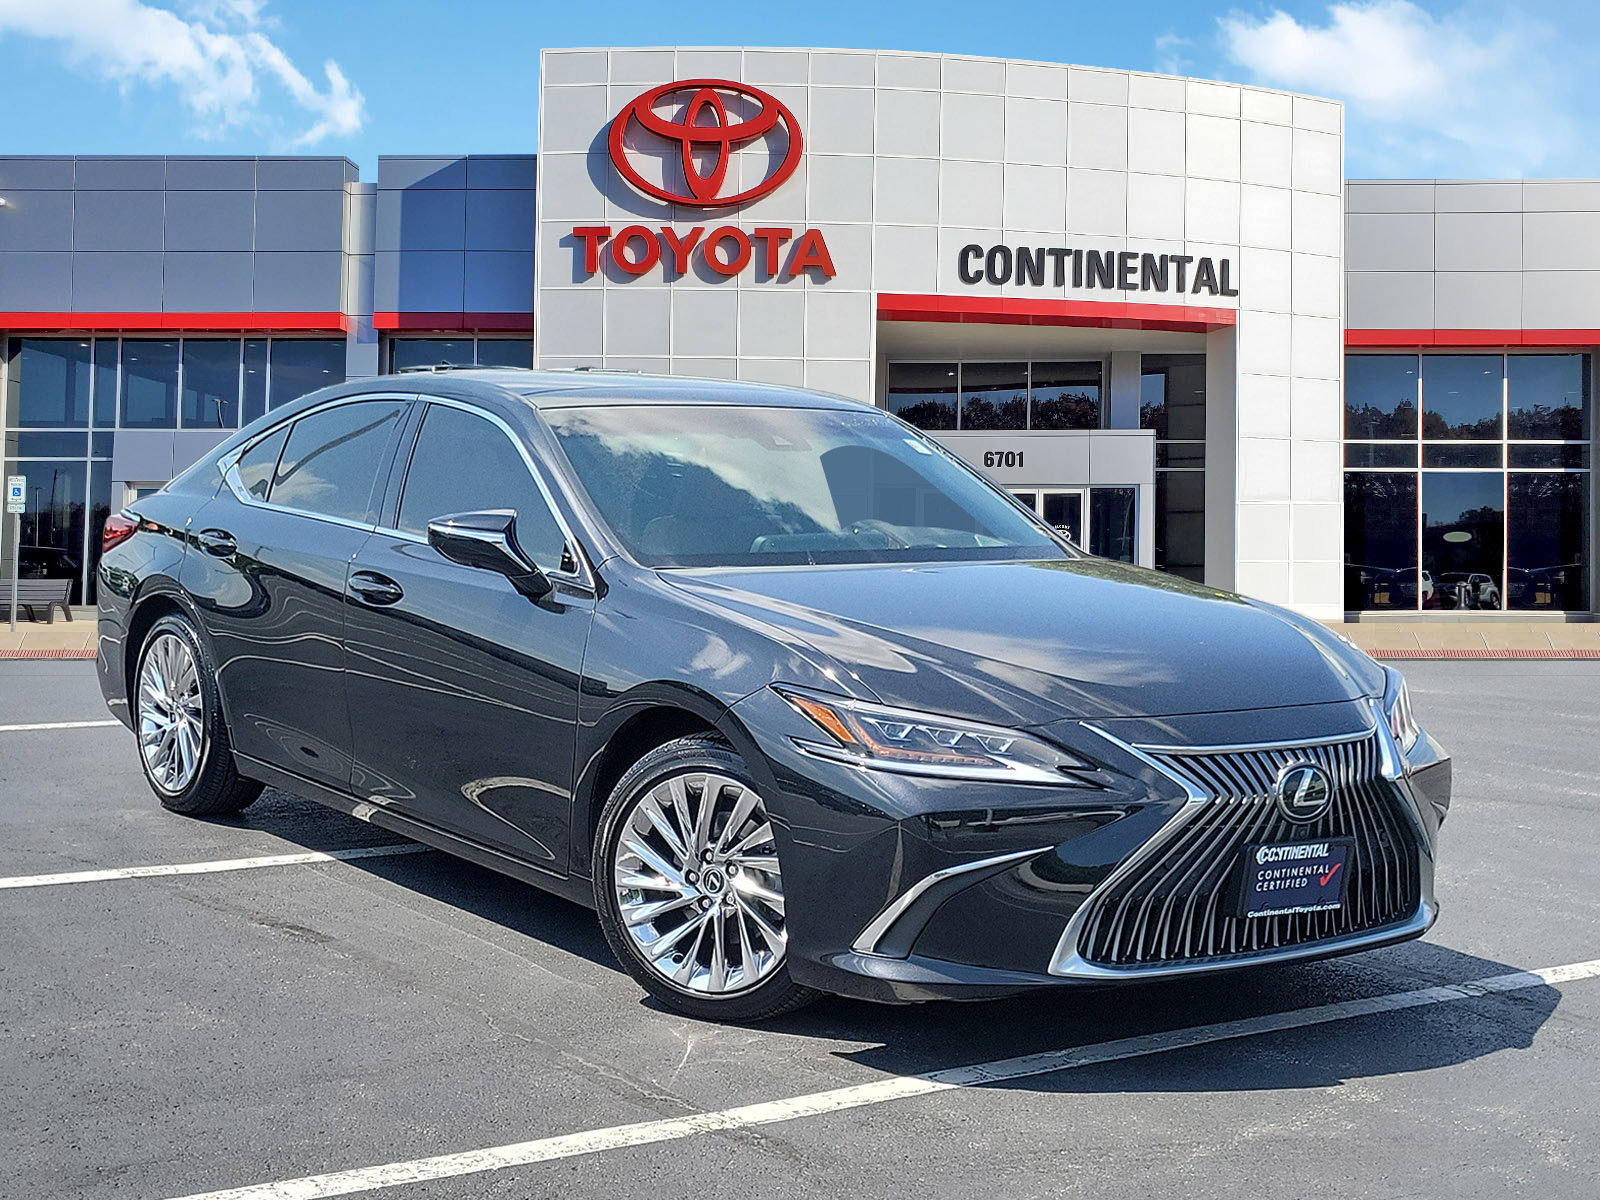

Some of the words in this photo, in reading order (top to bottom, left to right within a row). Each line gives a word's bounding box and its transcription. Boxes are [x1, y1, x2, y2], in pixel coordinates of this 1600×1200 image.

[573, 225, 837, 277] TOYOTA
[958, 243, 1239, 297] CONTINENTAL
[983, 450, 1025, 468] 6701
[1256, 843, 1330, 865] CONTINENTAL
[1257, 864, 1330, 880] CONTINENTAL
[1255, 877, 1308, 893] CERTIFIED
